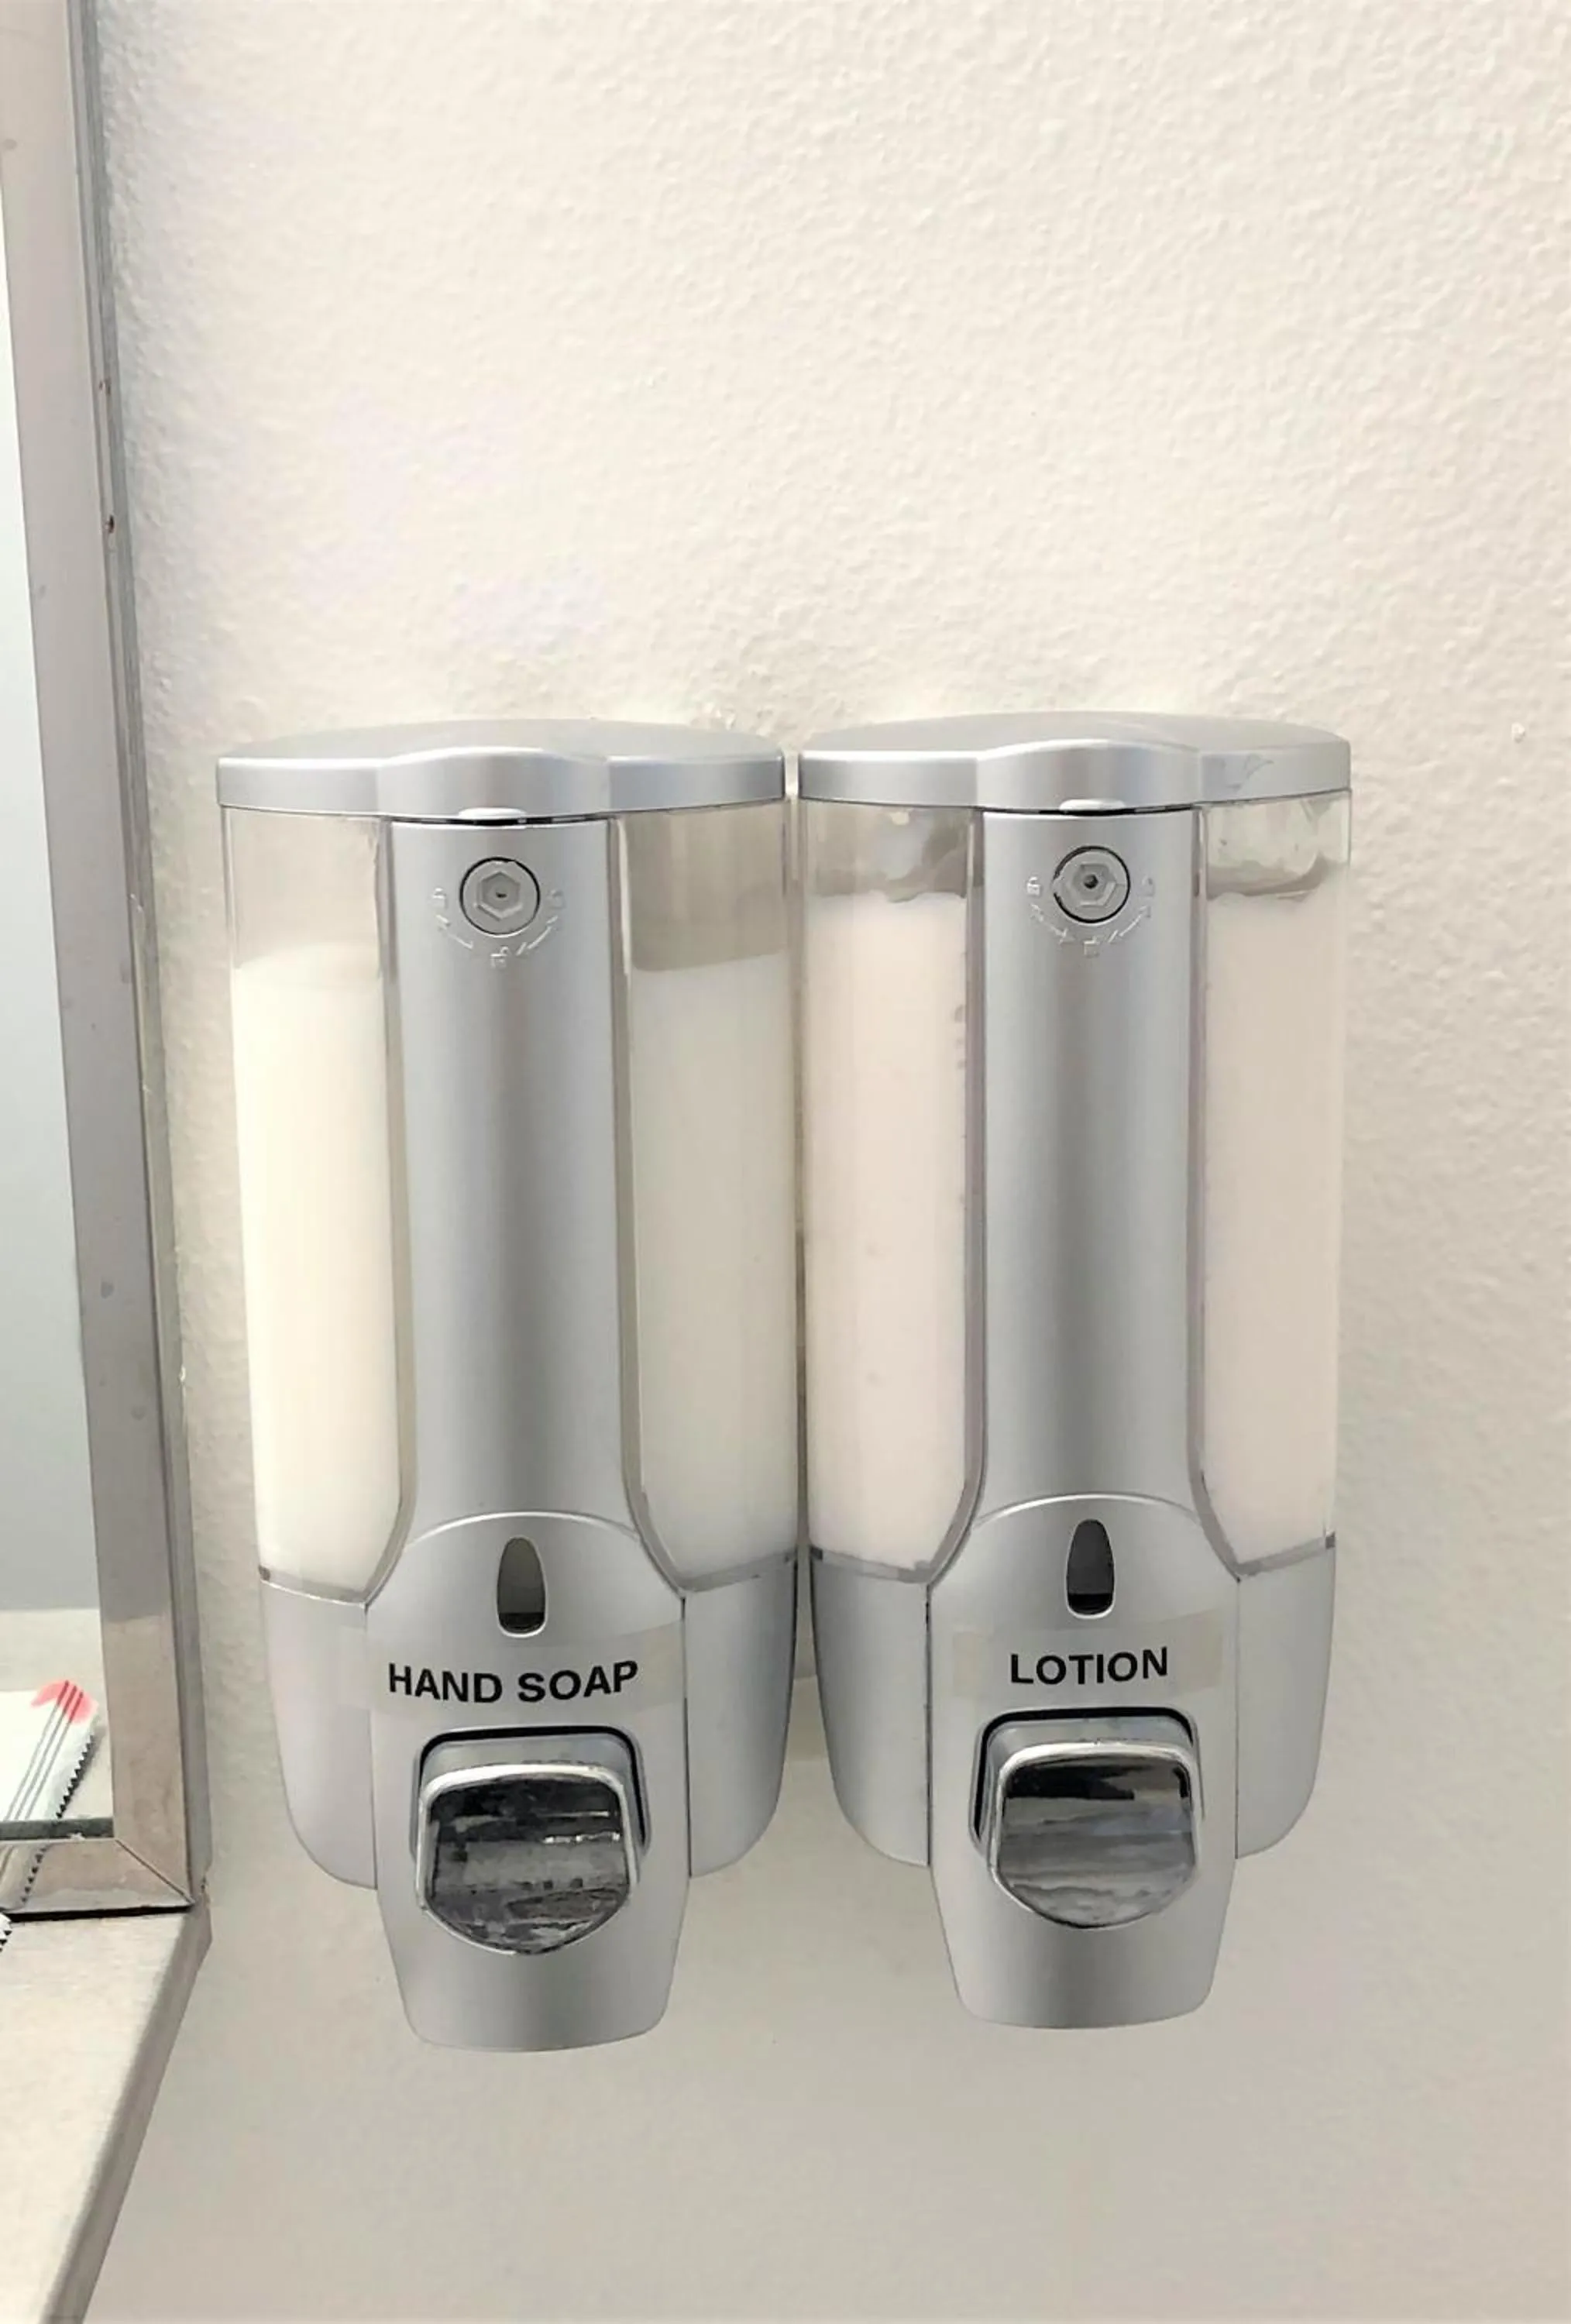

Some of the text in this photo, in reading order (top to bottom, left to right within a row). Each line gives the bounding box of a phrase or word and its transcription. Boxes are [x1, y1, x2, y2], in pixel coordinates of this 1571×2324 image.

[389, 1660, 638, 1703] HAND SOAP
[1010, 1646, 1168, 1685] LOTION
